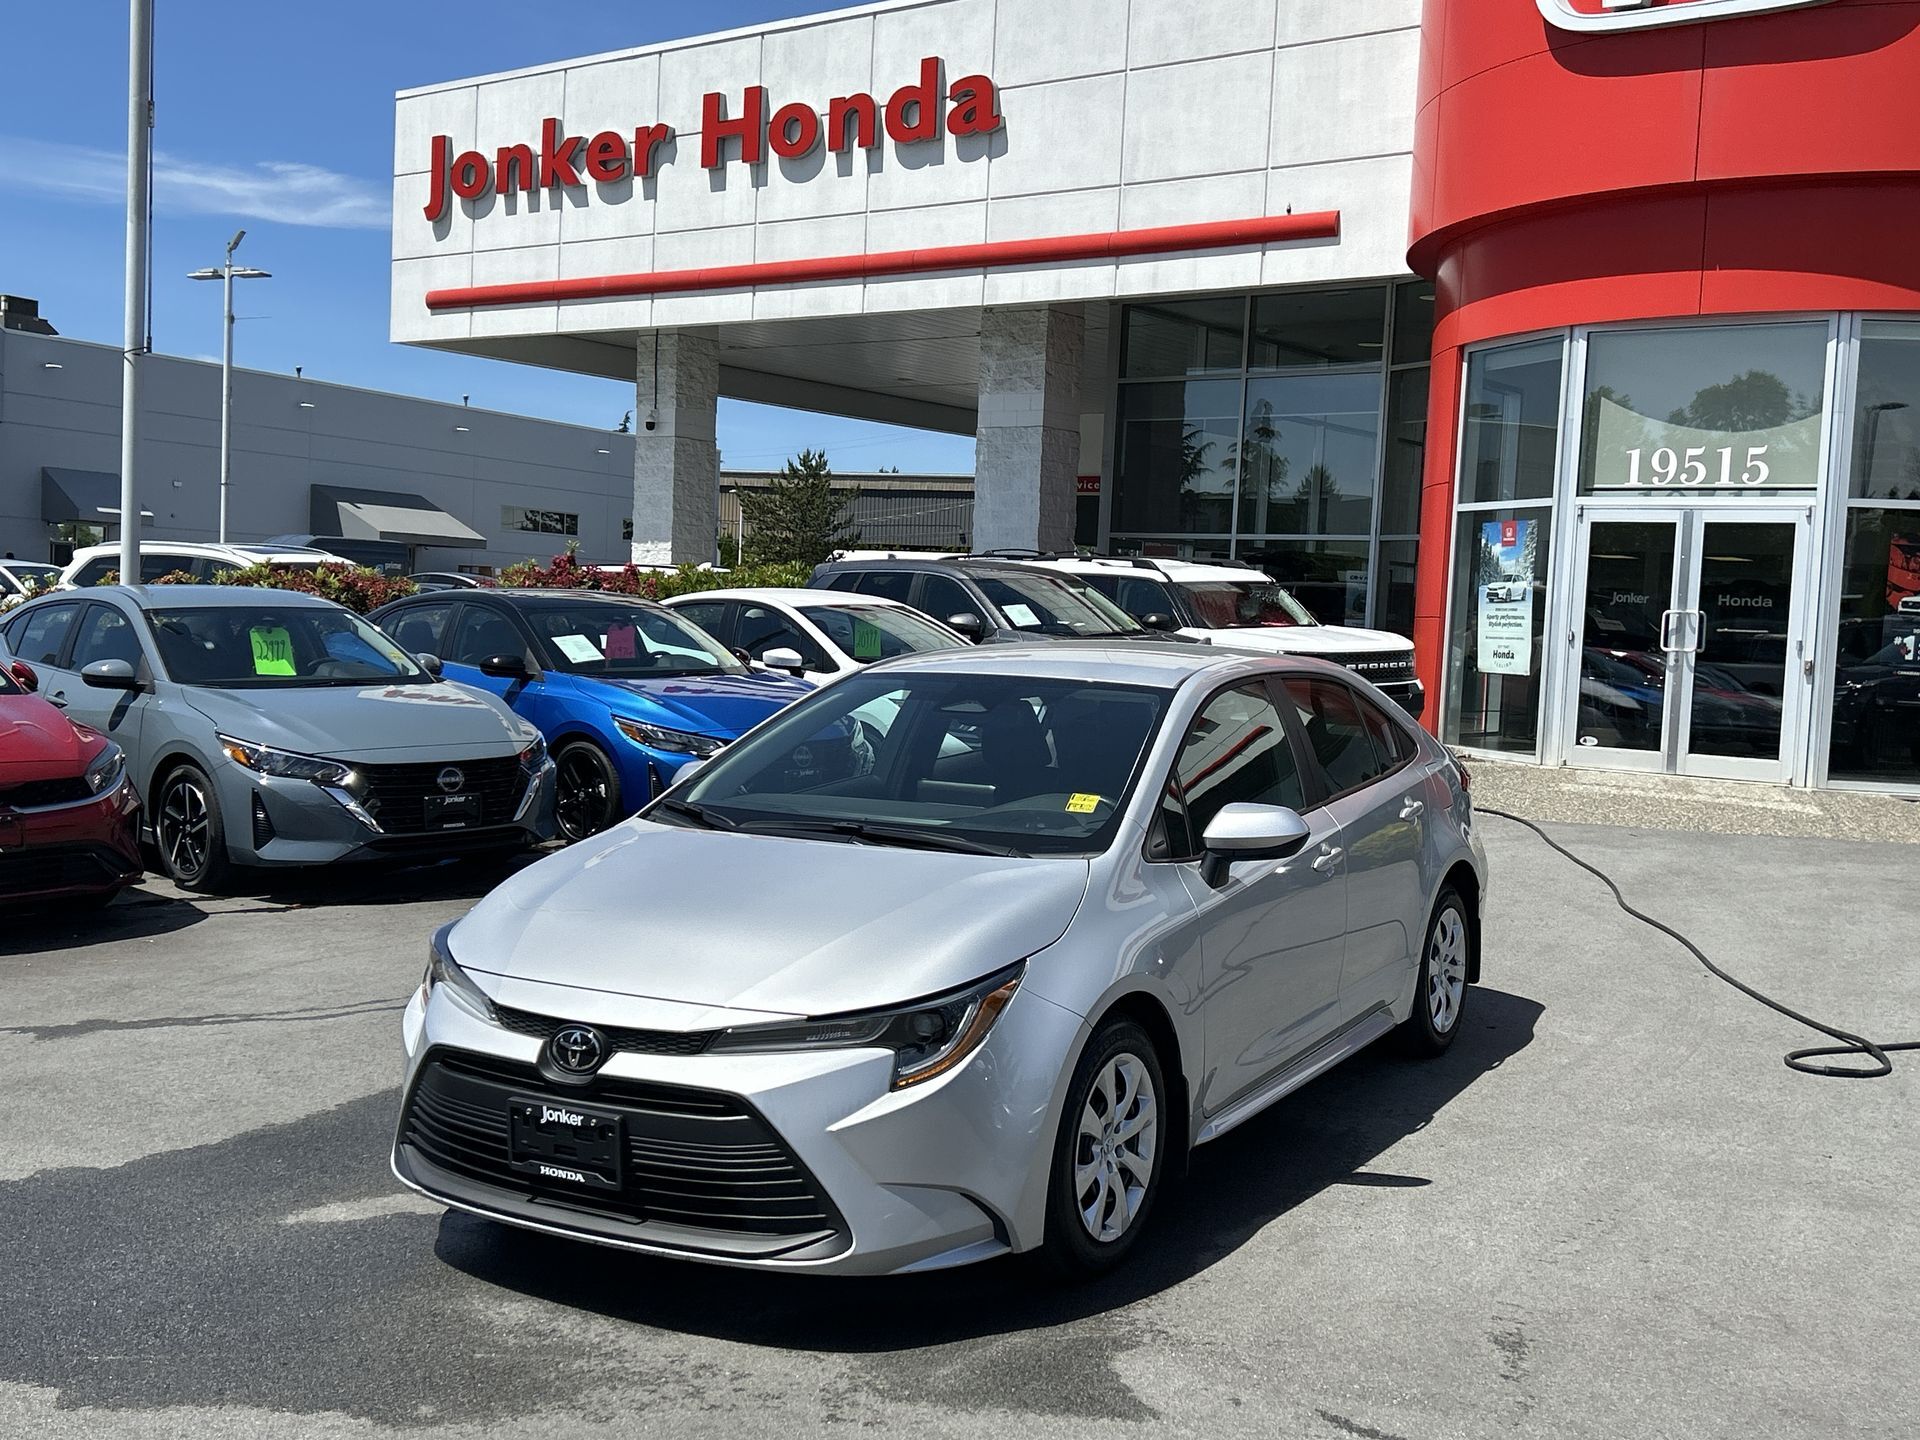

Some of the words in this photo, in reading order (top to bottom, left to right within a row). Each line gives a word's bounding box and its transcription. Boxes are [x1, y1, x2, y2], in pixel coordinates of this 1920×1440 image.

[424, 117, 675, 222] Jonker
[701, 56, 1005, 170] Honda
[1624, 445, 1770, 486] 19515
[1610, 592, 1650, 605] Jonker
[1718, 594, 1773, 607] Honda
[1493, 649, 1515, 659] Honda
[1345, 661, 1407, 670] BRONCO
[540, 1105, 584, 1126] Jonker
[540, 1166, 585, 1182] HONDA
